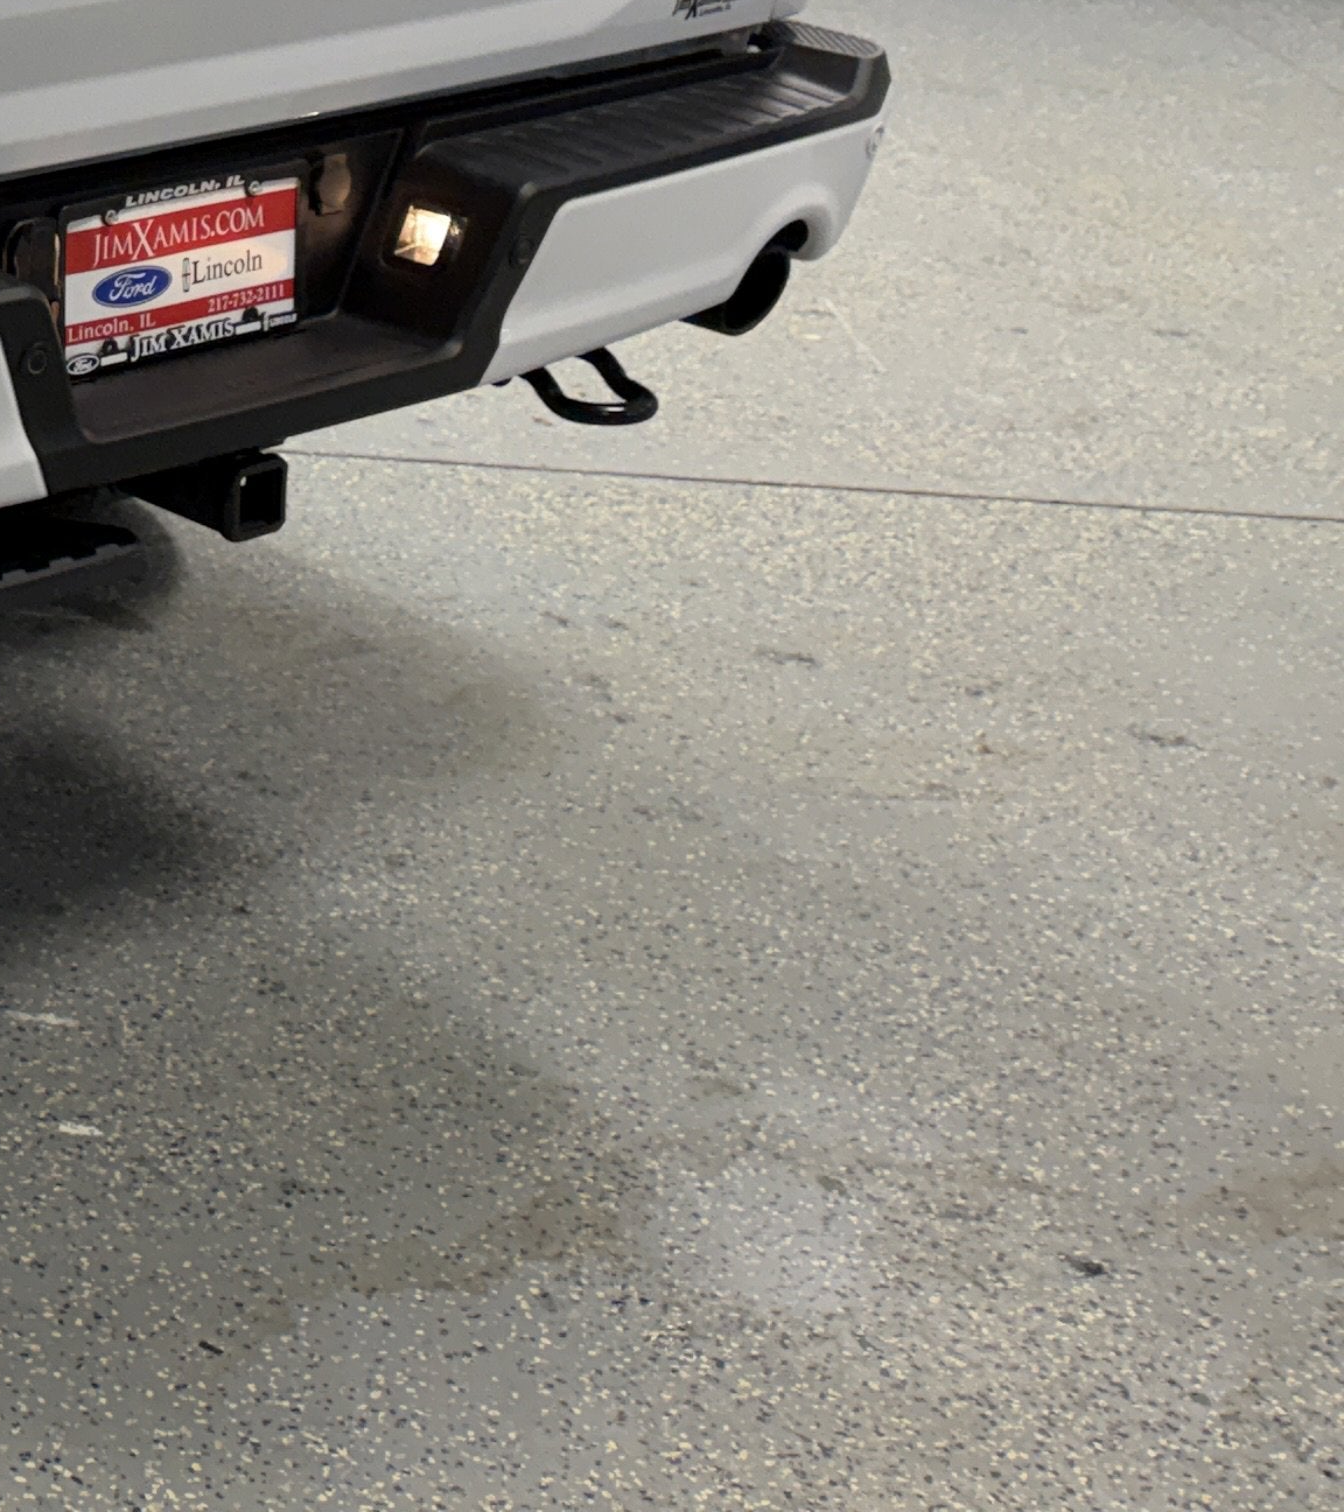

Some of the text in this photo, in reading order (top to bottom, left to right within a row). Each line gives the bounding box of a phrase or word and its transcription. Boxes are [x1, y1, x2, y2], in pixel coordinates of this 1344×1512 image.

[125, 174, 245, 207] LINCOLN, IL
[93, 205, 265, 267] JIMXAMIS.COM
[192, 249, 263, 285] Lincoln
[108, 272, 157, 301] Ford
[207, 283, 285, 314] 217-732-2111
[140, 313, 156, 328] IL
[131, 320, 234, 362] JIM XAMIS
